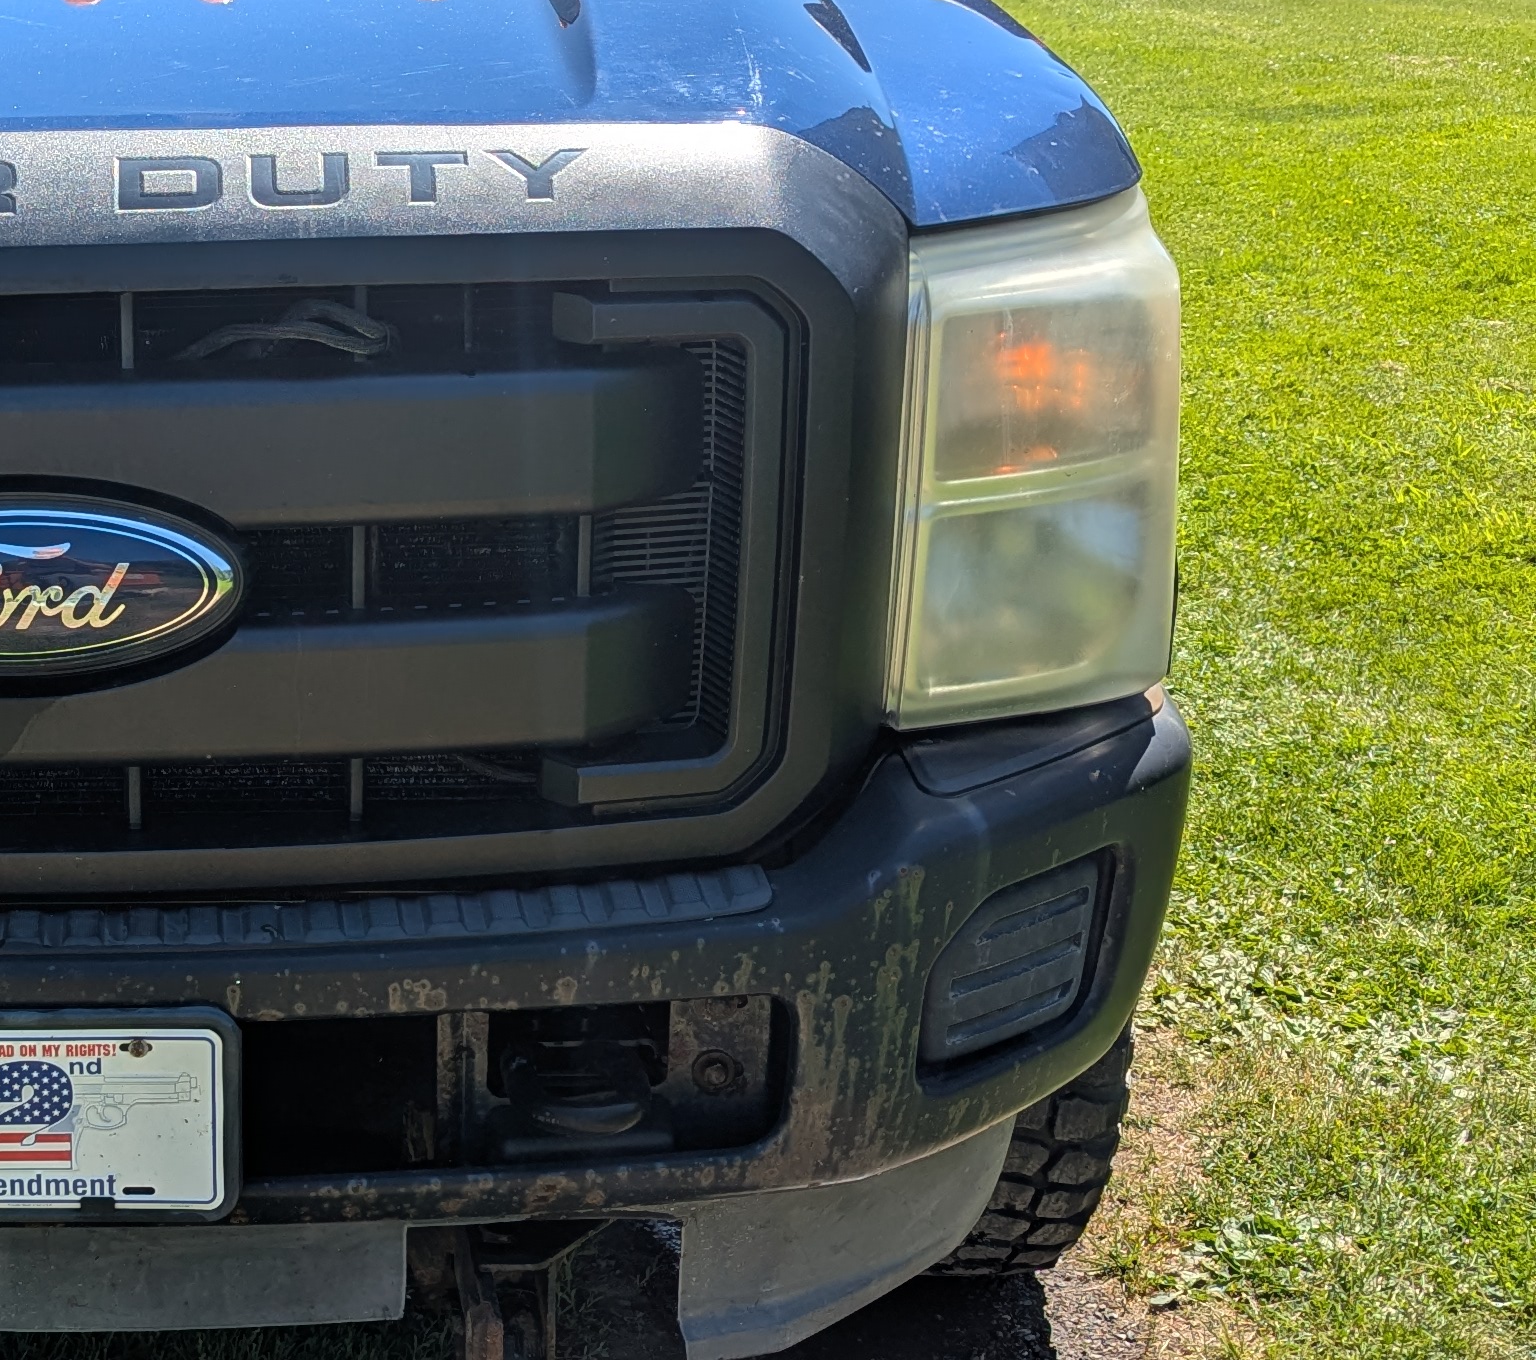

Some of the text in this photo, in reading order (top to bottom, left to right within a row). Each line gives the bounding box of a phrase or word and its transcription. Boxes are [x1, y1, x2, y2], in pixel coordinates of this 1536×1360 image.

[113, 147, 590, 213] DUTY
[19, 1044, 38, 1058] ON
[42, 1044, 61, 1058] MY
[65, 1044, 117, 1058] RIGHTS!
